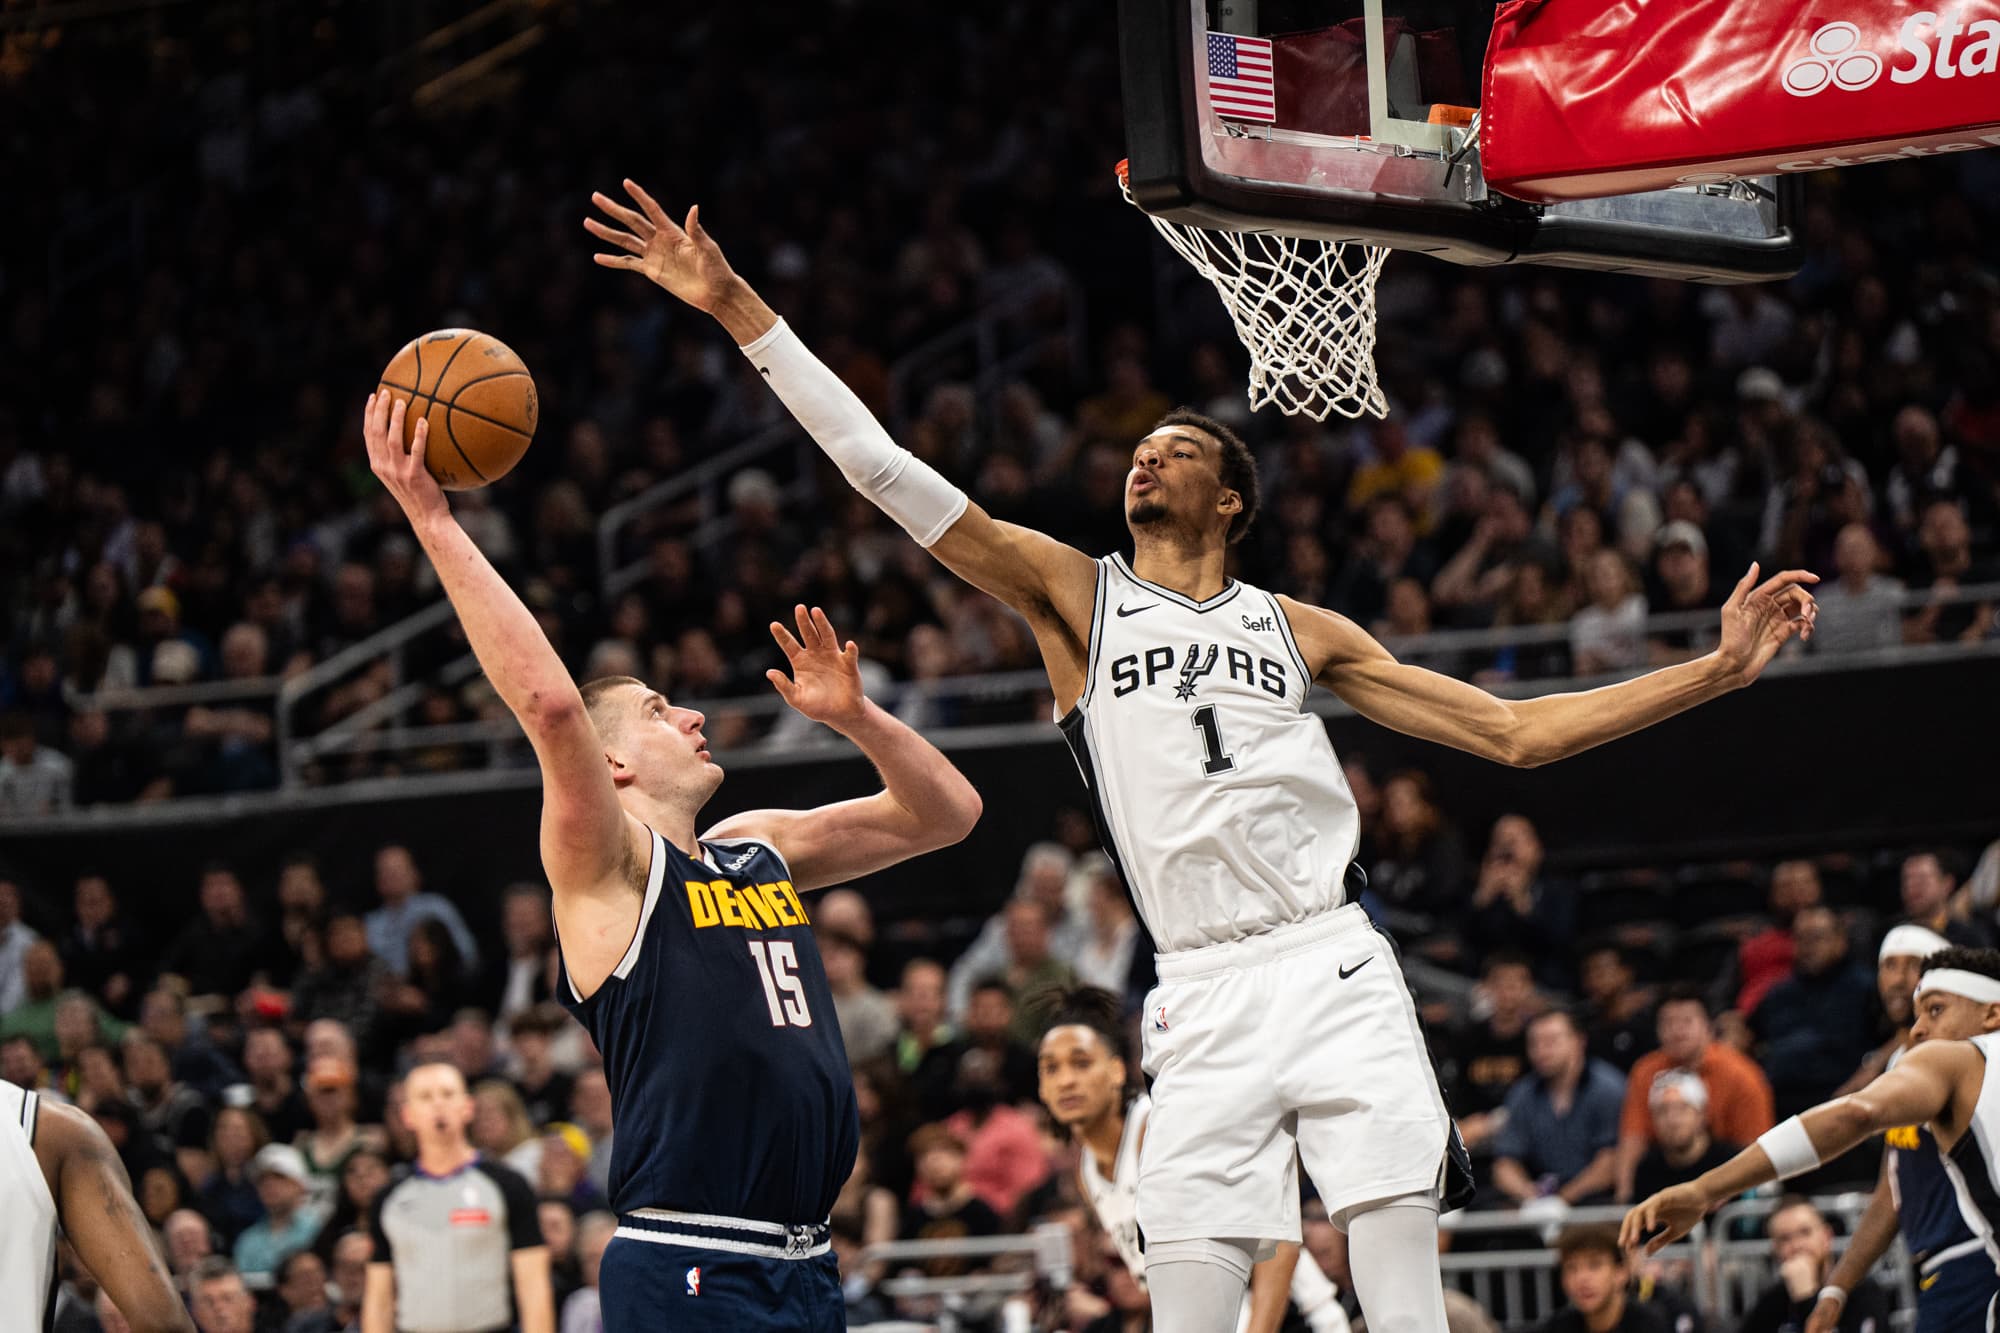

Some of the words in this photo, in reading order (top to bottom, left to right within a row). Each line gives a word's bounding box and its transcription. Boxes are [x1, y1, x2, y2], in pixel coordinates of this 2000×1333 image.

[1241, 614, 1275, 632] Self.
[1111, 644, 1286, 702] SPURS
[1191, 704, 1238, 777] 1
[684, 879, 811, 931] DENVER
[748, 940, 813, 1028] 15
